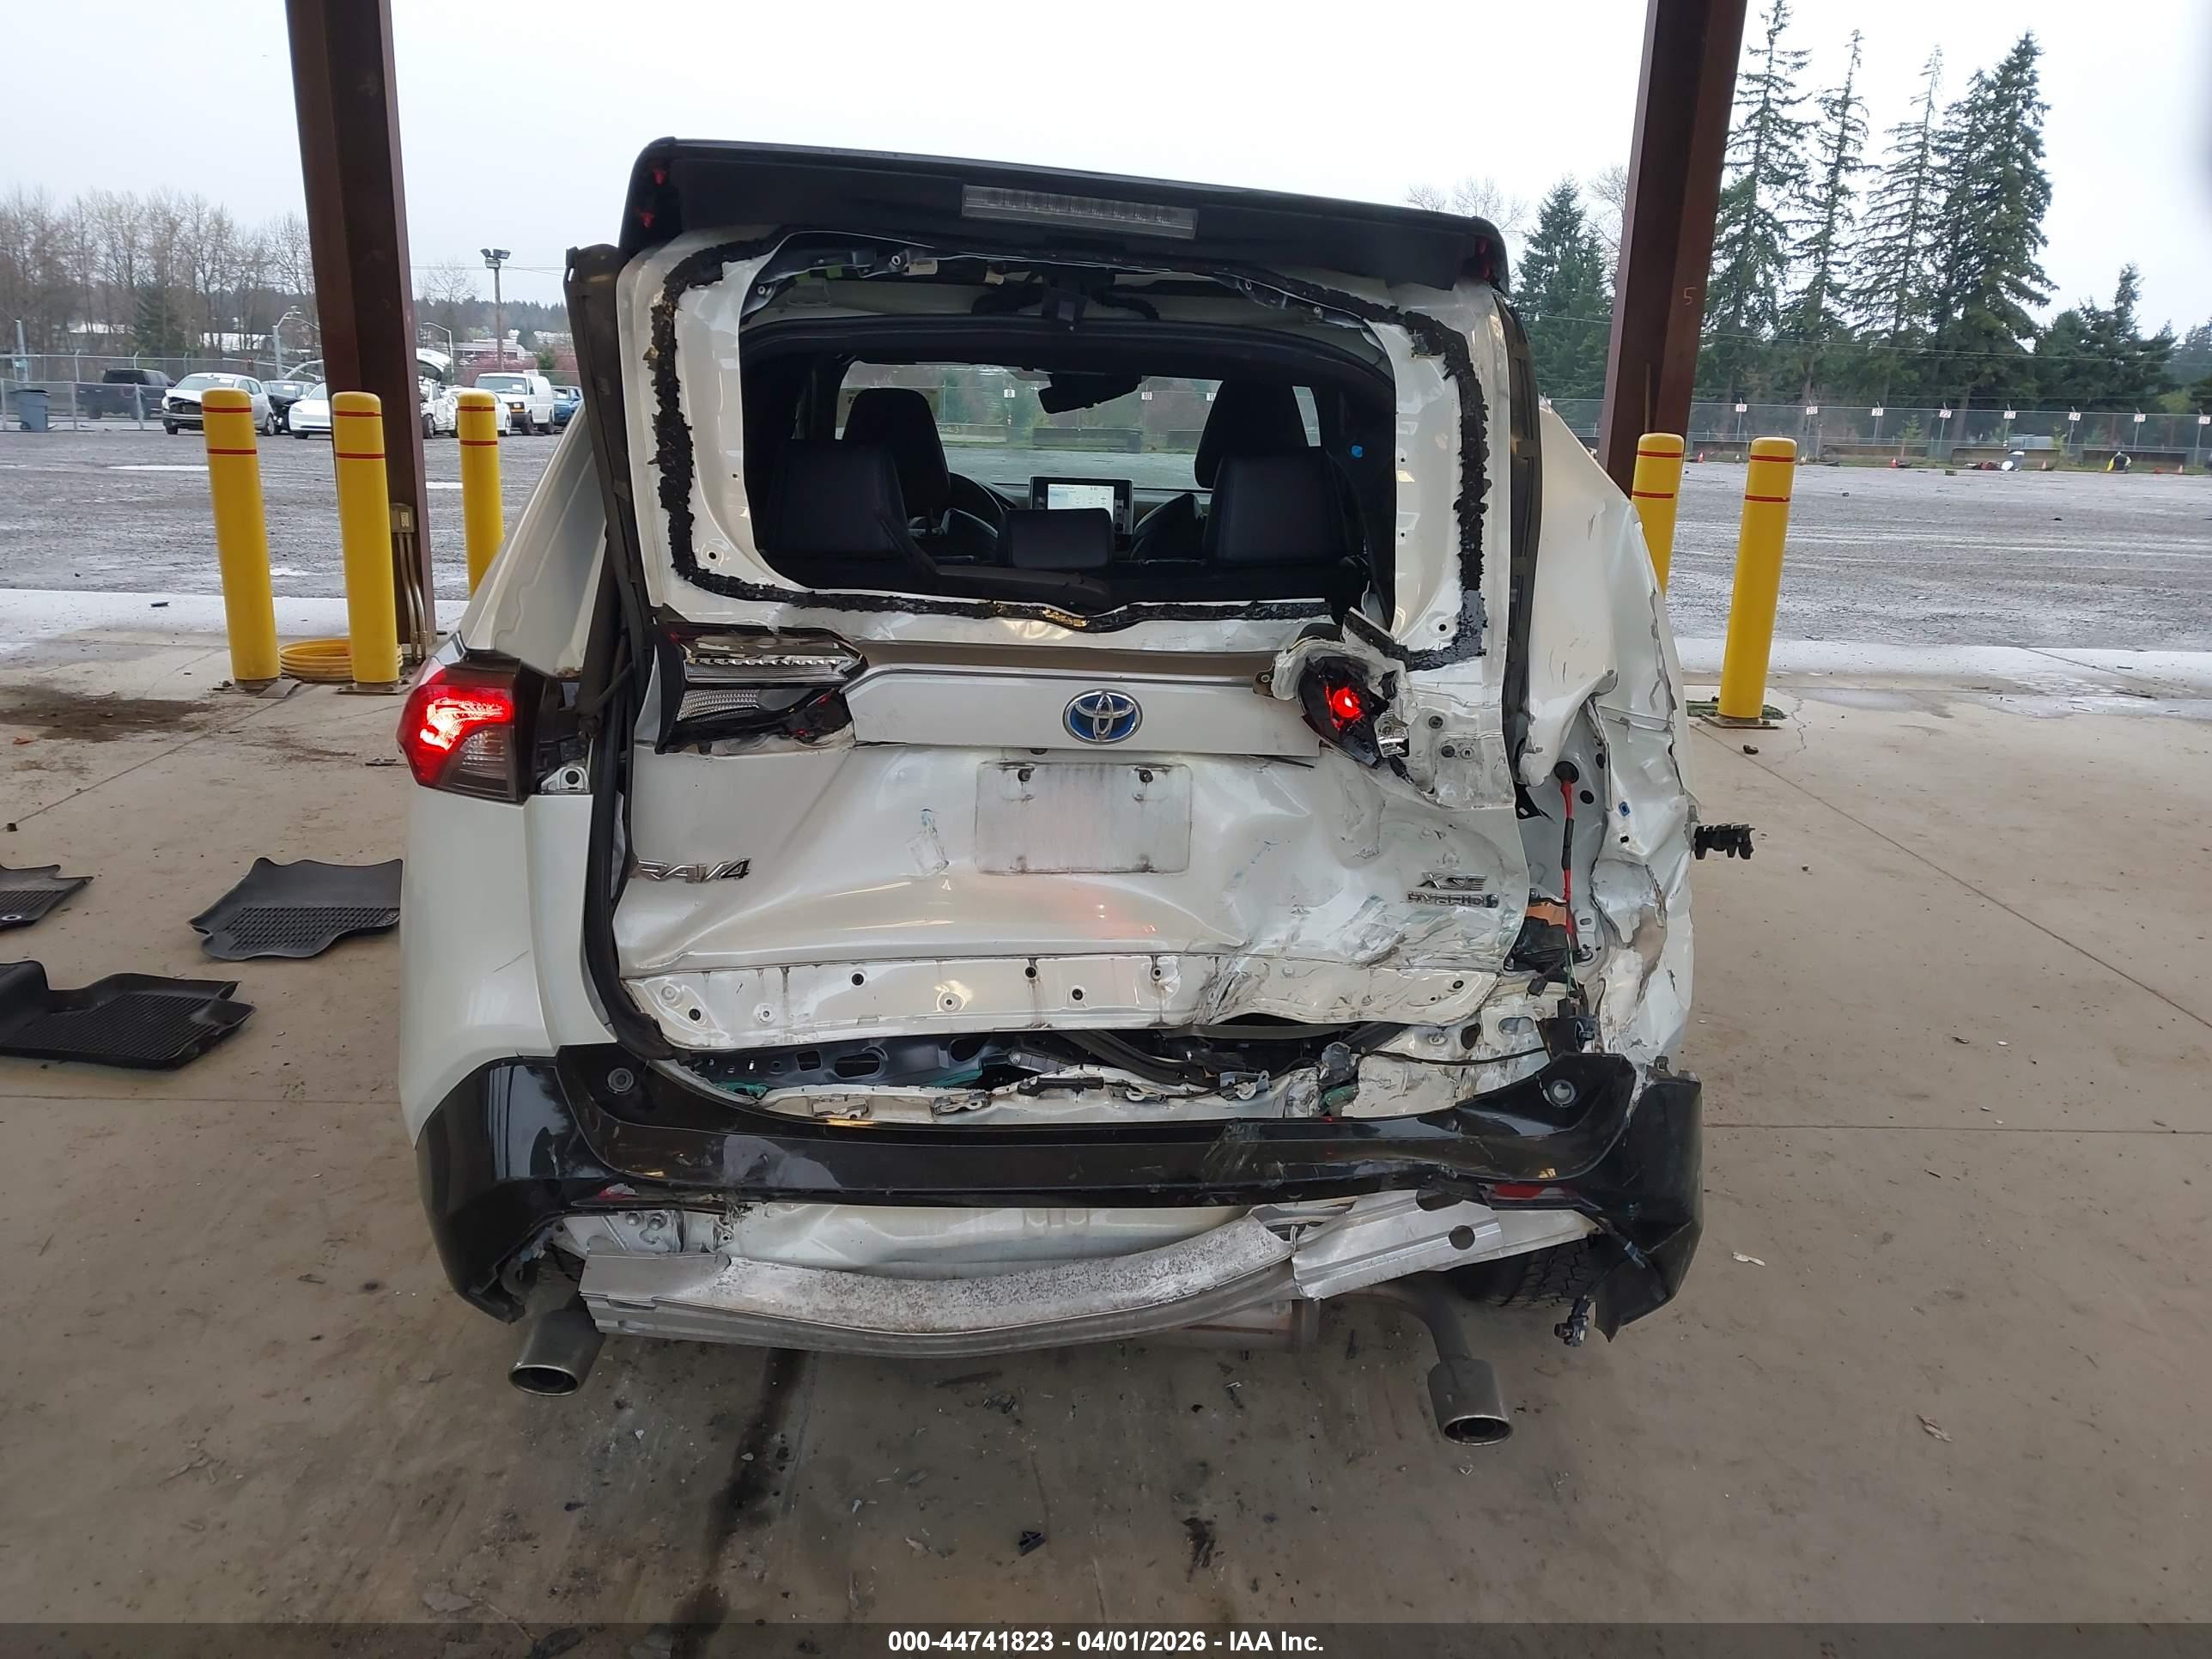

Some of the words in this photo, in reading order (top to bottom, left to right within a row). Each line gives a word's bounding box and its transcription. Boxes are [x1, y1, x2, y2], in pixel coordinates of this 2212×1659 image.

[1684, 287, 1697, 306] 5
[636, 859, 750, 883] RAV4
[1417, 872, 1487, 890] XSE
[1407, 890, 1485, 907] HYBRID
